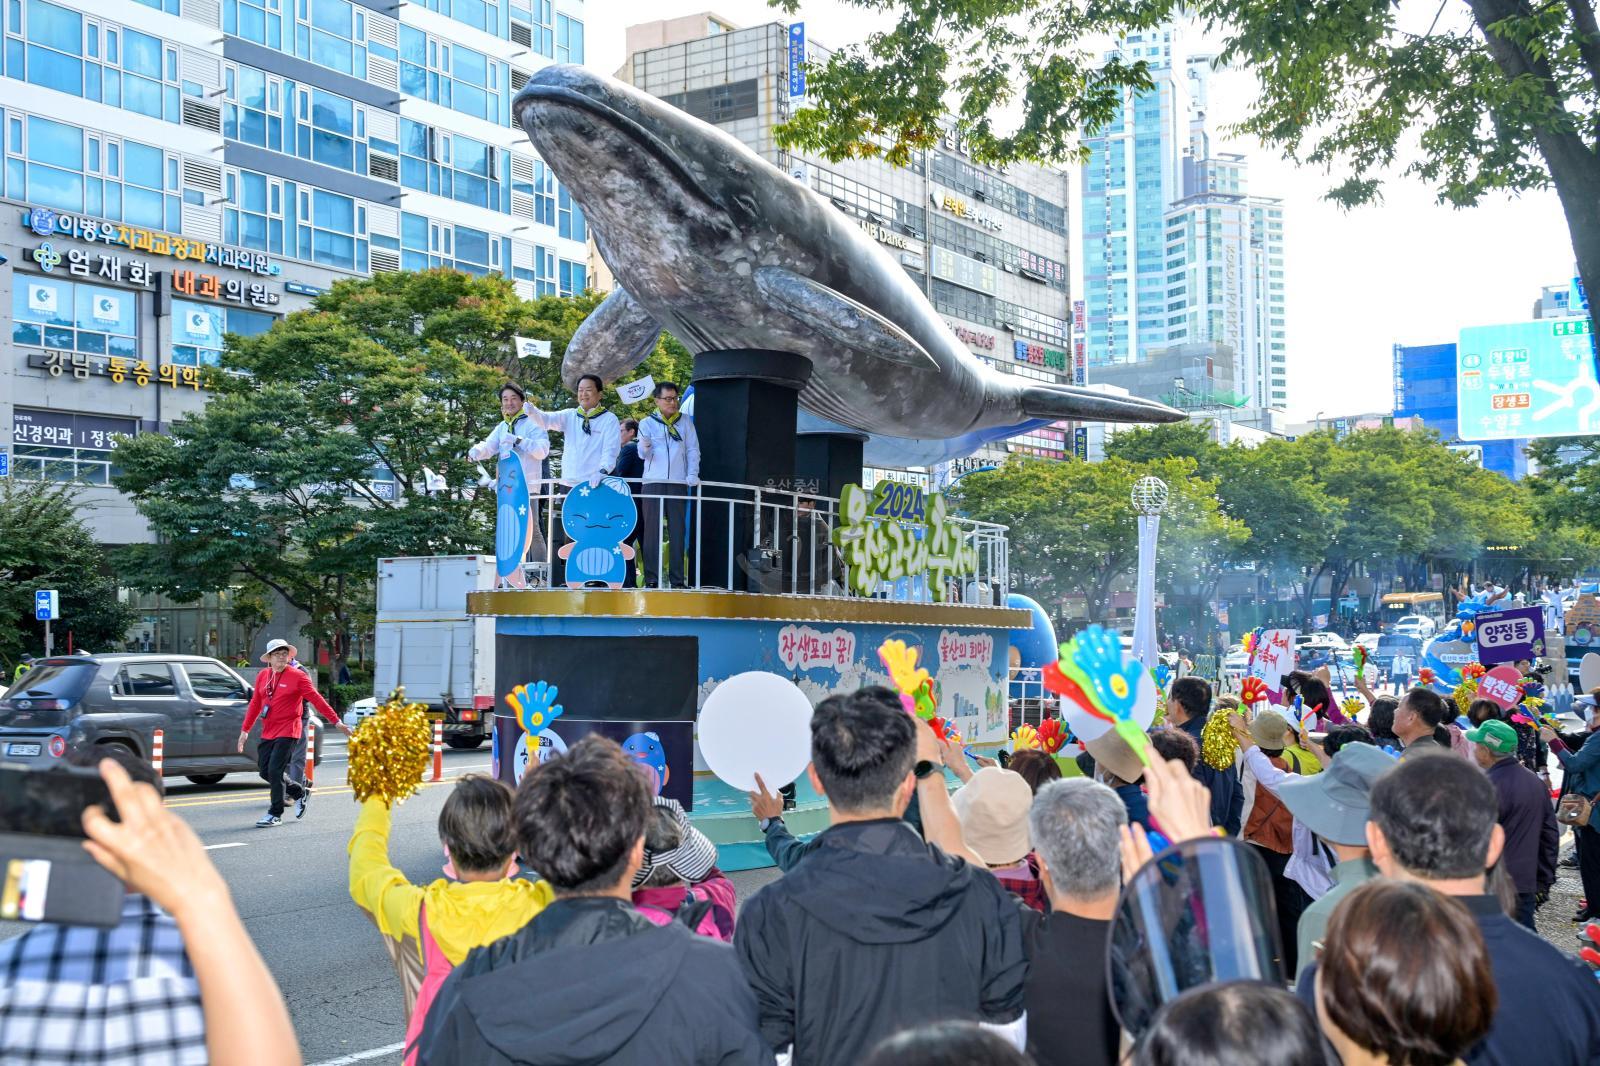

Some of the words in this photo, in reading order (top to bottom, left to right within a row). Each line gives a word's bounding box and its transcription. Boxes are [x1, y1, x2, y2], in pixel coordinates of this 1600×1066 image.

[880, 226, 907, 248] Dance
[68, 248, 152, 286] 엄재화
[174, 269, 268, 306] 내과의원
[44, 350, 91, 379] 강남
[109, 357, 213, 390] 통증의학
[1494, 395, 1529, 408] 장생포
[13, 424, 73, 444] 신경외과
[875, 482, 925, 521] 2024
[1484, 621, 1528, 644] 양정동
[782, 632, 832, 664] 장생포의
[835, 635, 852, 665] 꿈!
[940, 639, 967, 663] 울산의
[969, 638, 991, 663] 희망!
